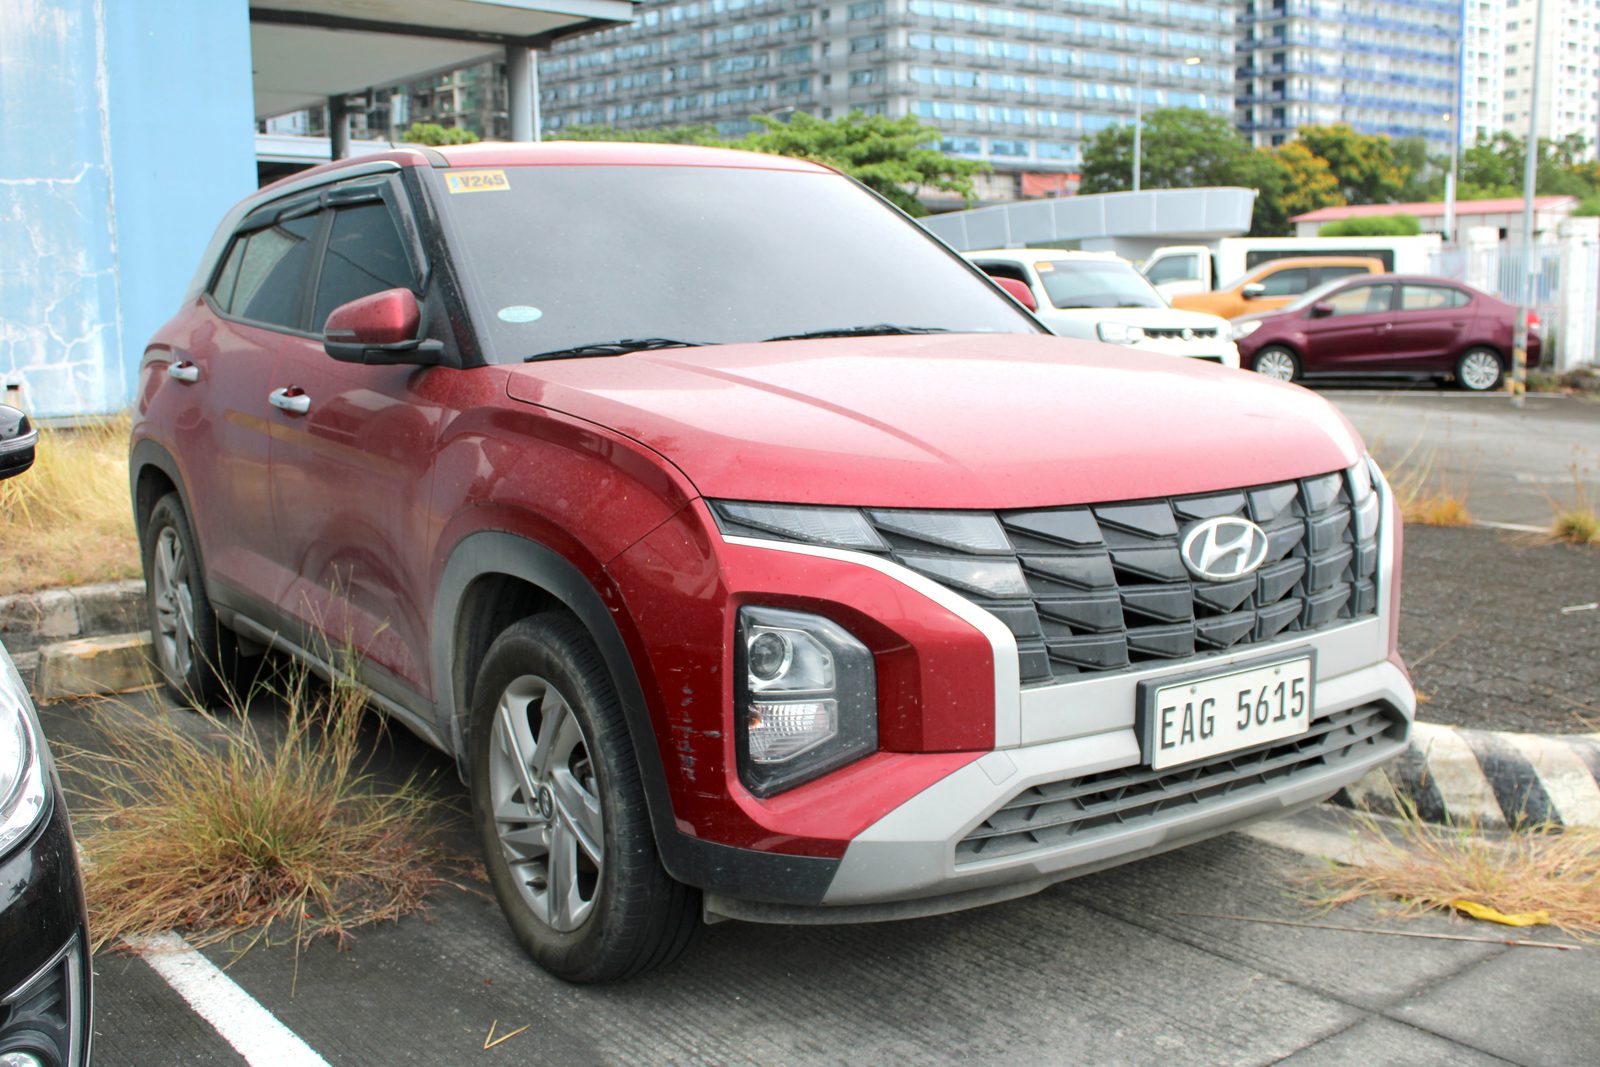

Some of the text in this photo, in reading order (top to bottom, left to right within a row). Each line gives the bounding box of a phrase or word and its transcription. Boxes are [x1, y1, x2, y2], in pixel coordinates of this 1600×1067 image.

[460, 174, 505, 188] V245
[1161, 677, 1304, 750] EAG 5615
